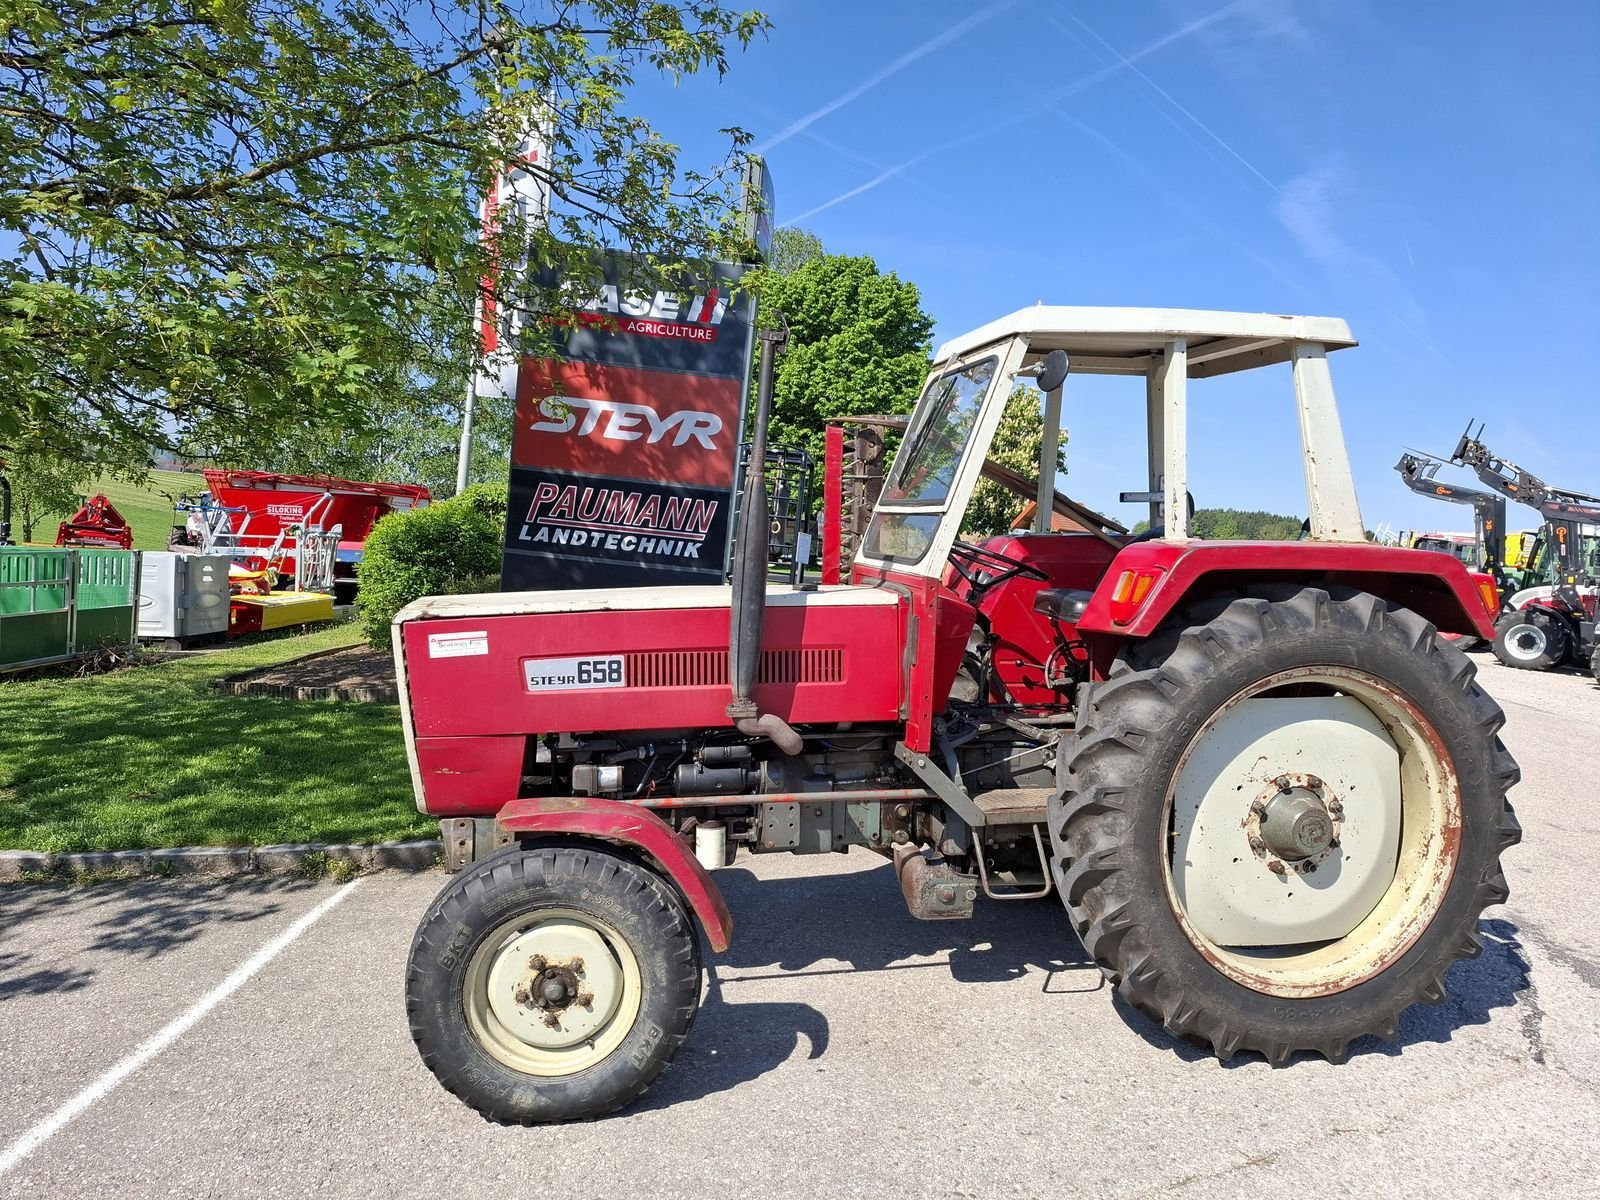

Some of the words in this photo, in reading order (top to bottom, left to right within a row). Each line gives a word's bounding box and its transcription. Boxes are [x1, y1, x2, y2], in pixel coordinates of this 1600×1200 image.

[627, 322, 713, 340] AGRICULTURE
[530, 395, 723, 450] STEYR
[267, 506, 303, 514] SILOKING
[525, 482, 719, 533] PAUMANN
[518, 525, 703, 559] LANDTECHNIK
[530, 675, 575, 686] STEYR
[577, 660, 622, 684] 658
[439, 922, 472, 971] BKT
[628, 1020, 663, 1070] BKT
